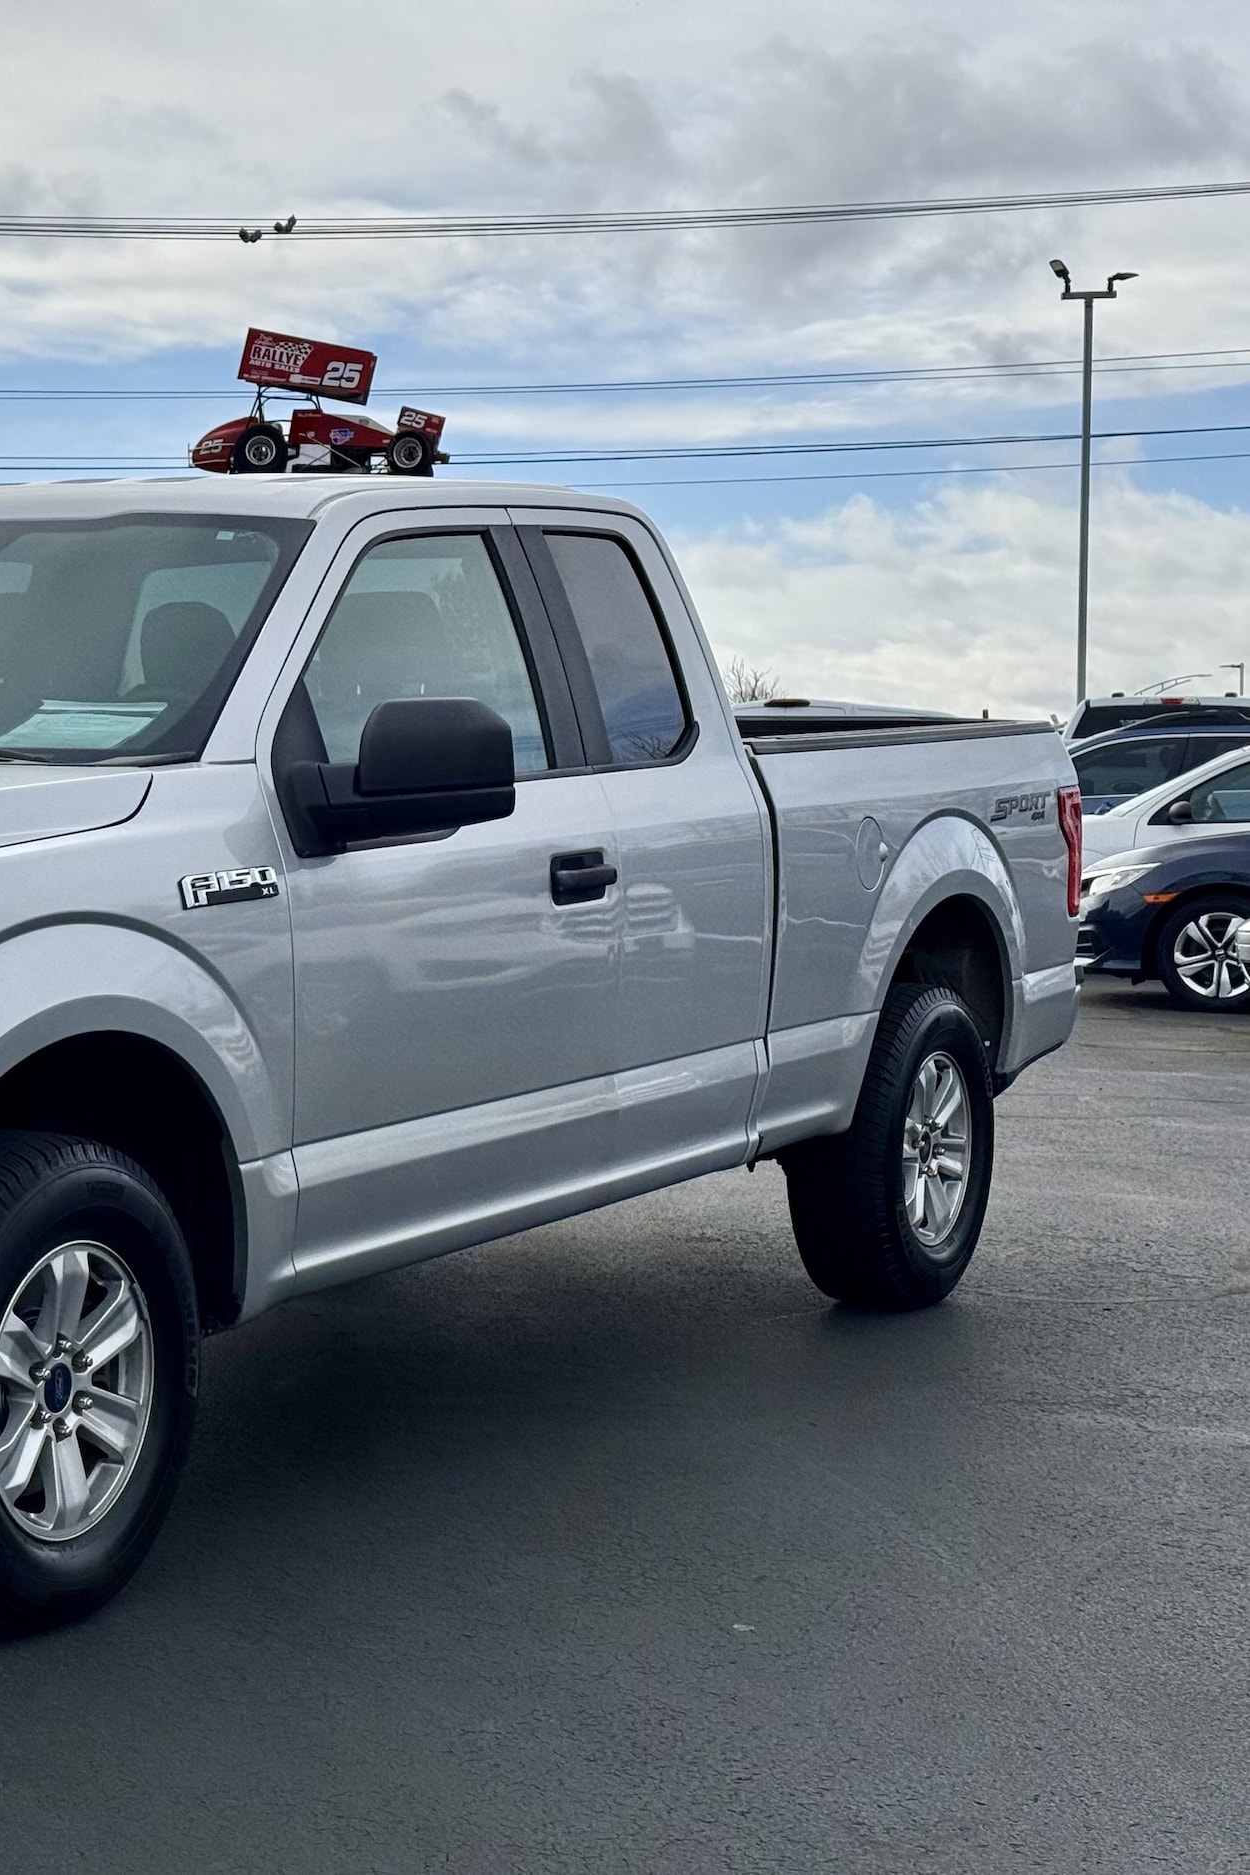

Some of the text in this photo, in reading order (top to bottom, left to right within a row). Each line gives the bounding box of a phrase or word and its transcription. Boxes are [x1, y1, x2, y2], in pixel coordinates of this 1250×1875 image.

[252, 346, 303, 366] RALLYE
[249, 359, 271, 369] AUTO
[274, 363, 300, 373] SALES
[321, 361, 363, 389] 25
[400, 410, 428, 428] 25
[200, 439, 224, 455] 25
[990, 791, 1052, 821] SPORT
[261, 887, 275, 896] XL
